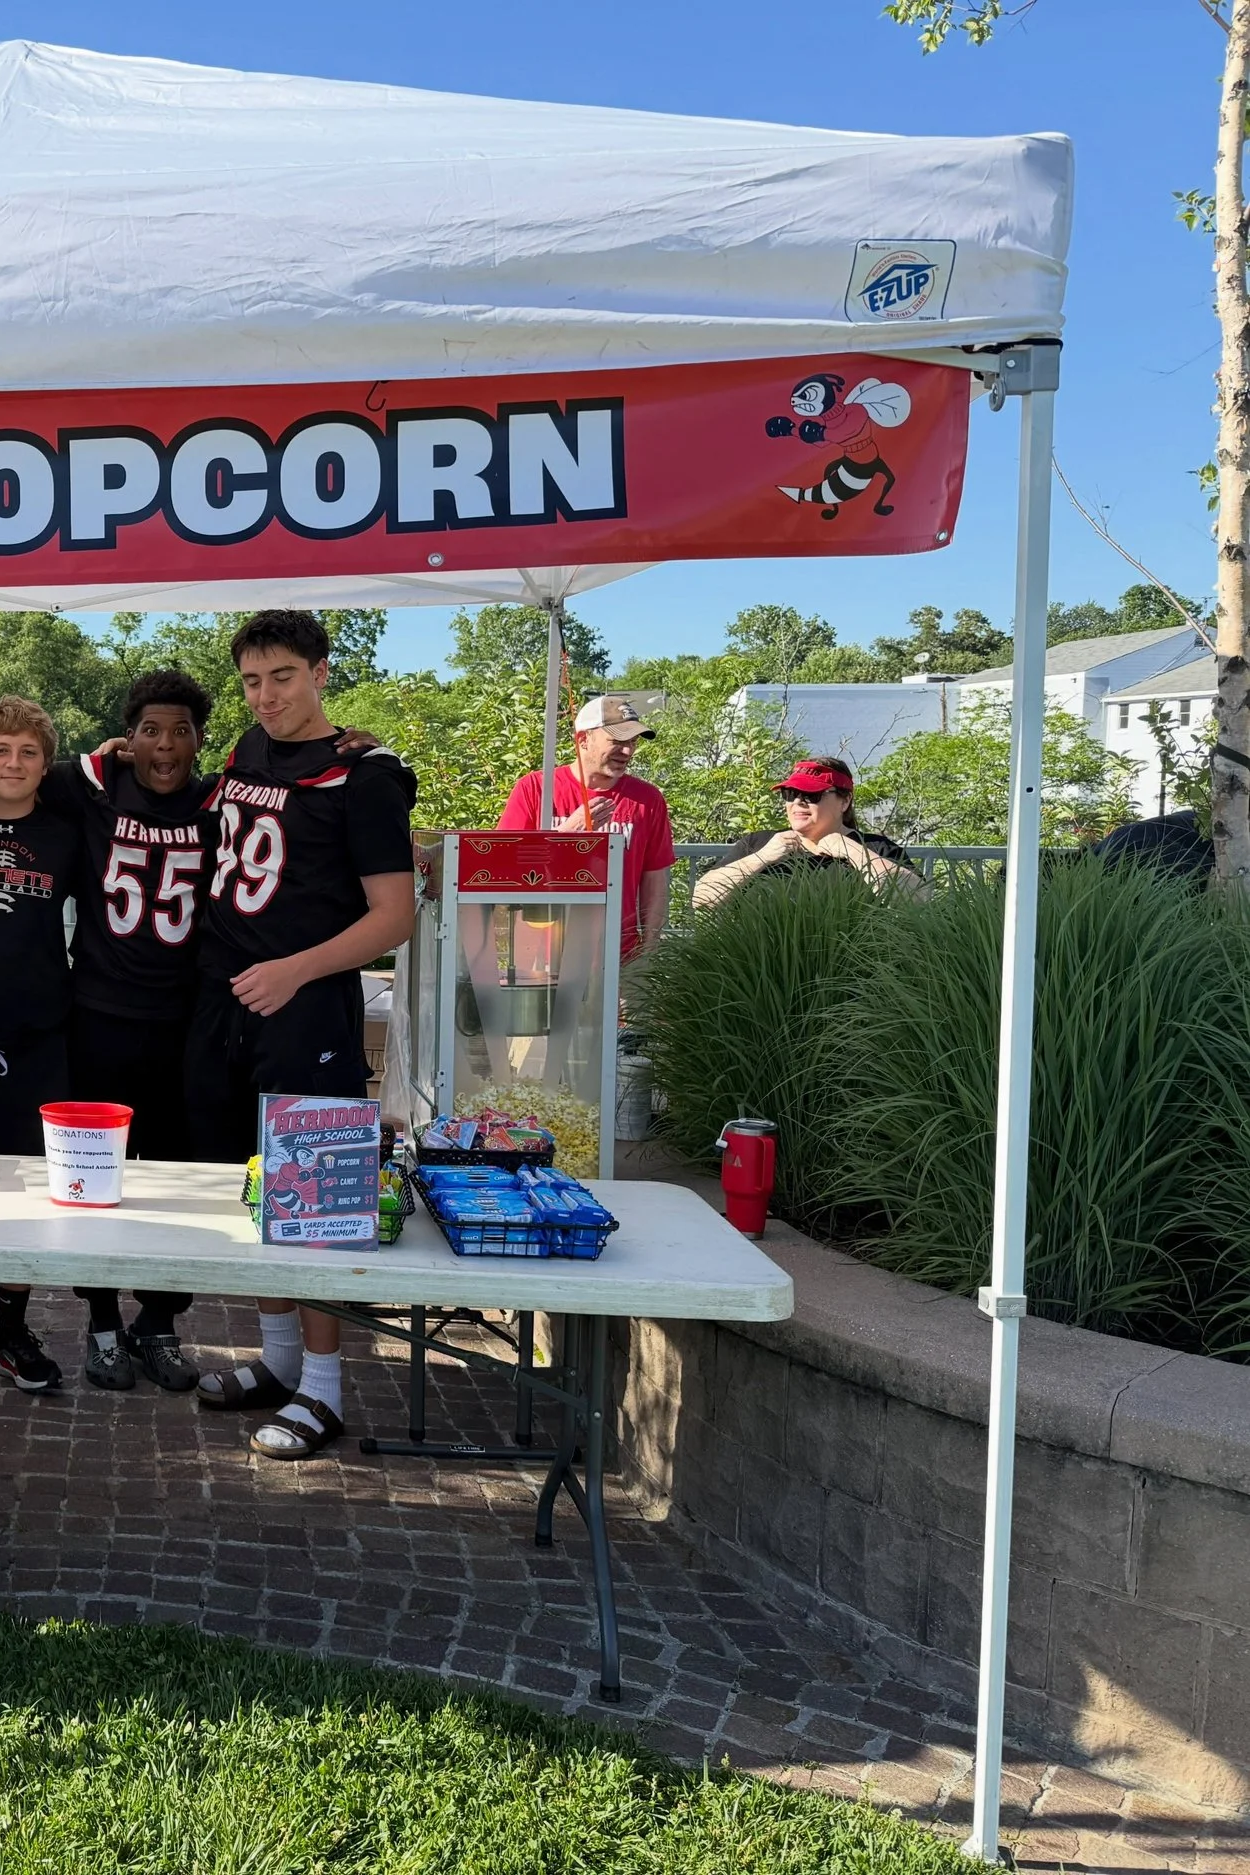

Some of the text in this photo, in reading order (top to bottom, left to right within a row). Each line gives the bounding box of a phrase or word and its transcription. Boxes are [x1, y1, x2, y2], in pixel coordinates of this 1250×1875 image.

[224, 779, 289, 812] HERNDON
[114, 816, 200, 844] HERNDON
[102, 840, 205, 947] 55
[272, 1104, 377, 1137] HERNDON
[52, 1128, 106, 1140] DONATIONS!
[294, 1129, 366, 1145] HIGH SCHOOL
[337, 1156, 374, 1167] POPCORN $5
[340, 1176, 374, 1186] CANDY $2
[350, 1197, 361, 1205] POP
[365, 1195, 374, 1205] $1
[327, 1220, 362, 1228] ACCEPTED
[305, 1228, 358, 1238] $5 MINIMUM
